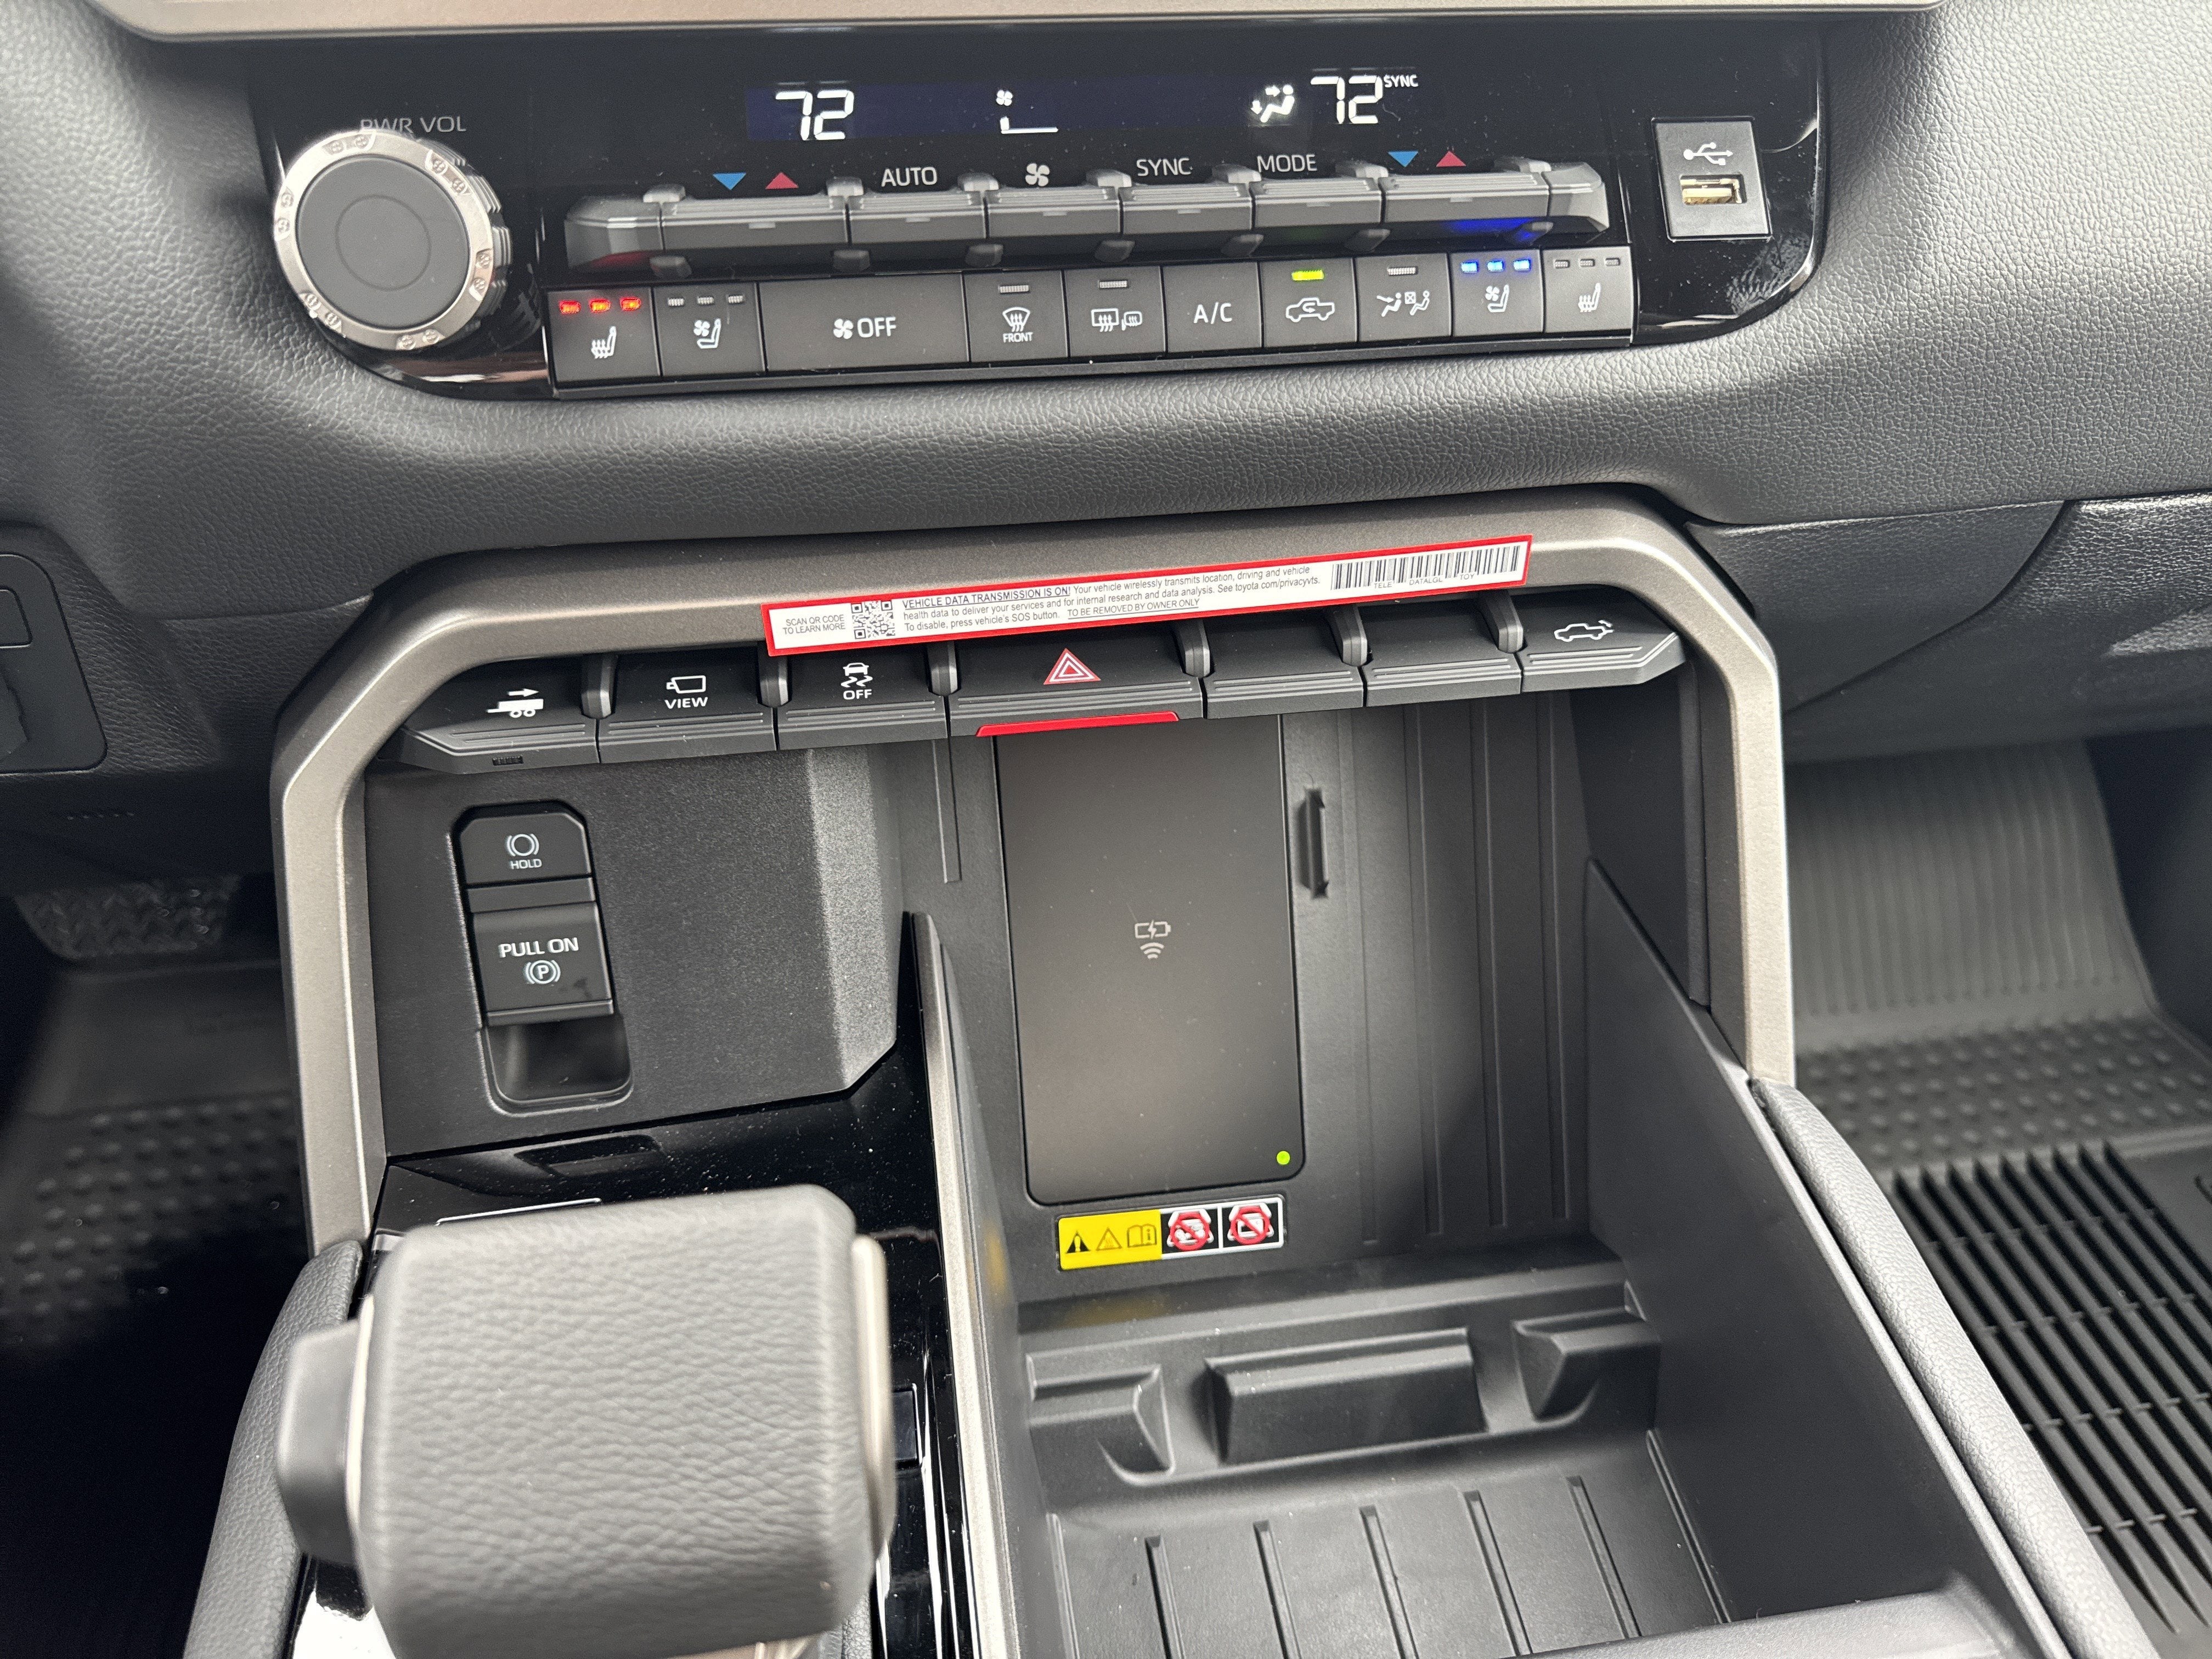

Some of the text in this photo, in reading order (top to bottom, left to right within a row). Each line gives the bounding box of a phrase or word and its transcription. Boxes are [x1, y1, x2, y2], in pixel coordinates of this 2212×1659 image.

[1384, 75, 1419, 88] SYNC
[1310, 75, 1383, 124] 72
[775, 89, 854, 140] 72
[360, 115, 466, 133] PWR VOL
[1136, 157, 1191, 177] SYNC
[1257, 154, 1317, 173] MODE
[881, 167, 938, 187] AUTO
[1193, 303, 1233, 324] A/C
[857, 317, 896, 338] OFF
[1003, 331, 1034, 343] FRONT
[902, 566, 1310, 608] VEHICLE DATA TRANSMISSION IS ON! Your vehicle wirelessly transmits location, driving and vehicle
[904, 611, 929, 620] health
[931, 609, 949, 618] data
[962, 606, 988, 616] deliver
[991, 605, 1009, 615] your
[1011, 601, 1044, 611] services
[1046, 599, 1061, 608] and
[1064, 598, 1074, 607] for
[1076, 595, 1106, 605] internal
[1108, 592, 1142, 602] research
[1144, 590, 1159, 599] and
[1162, 589, 1179, 598] data
[1181, 586, 1215, 597] analysis.
[1217, 584, 1233, 593] See
[1068, 609, 1078, 617] TO
[1081, 607, 1091, 616] BE
[1093, 604, 1133, 614] REMOVED
[1147, 600, 1177, 610] OWNER
[1178, 599, 1200, 607] ONLY
[786, 614, 844, 627] SCAN QR CODE
[795, 624, 821, 634] LEARN
[823, 622, 845, 631] MORE
[905, 623, 915, 631] To
[916, 620, 949, 630] disable,
[951, 619, 973, 628] press
[974, 614, 1009, 625] vehicle's
[1012, 613, 1030, 622] SOS
[664, 696, 708, 709] VIEW
[843, 688, 873, 700] OFF
[510, 859, 542, 870] HOLD
[498, 937, 579, 957] PULL ON
